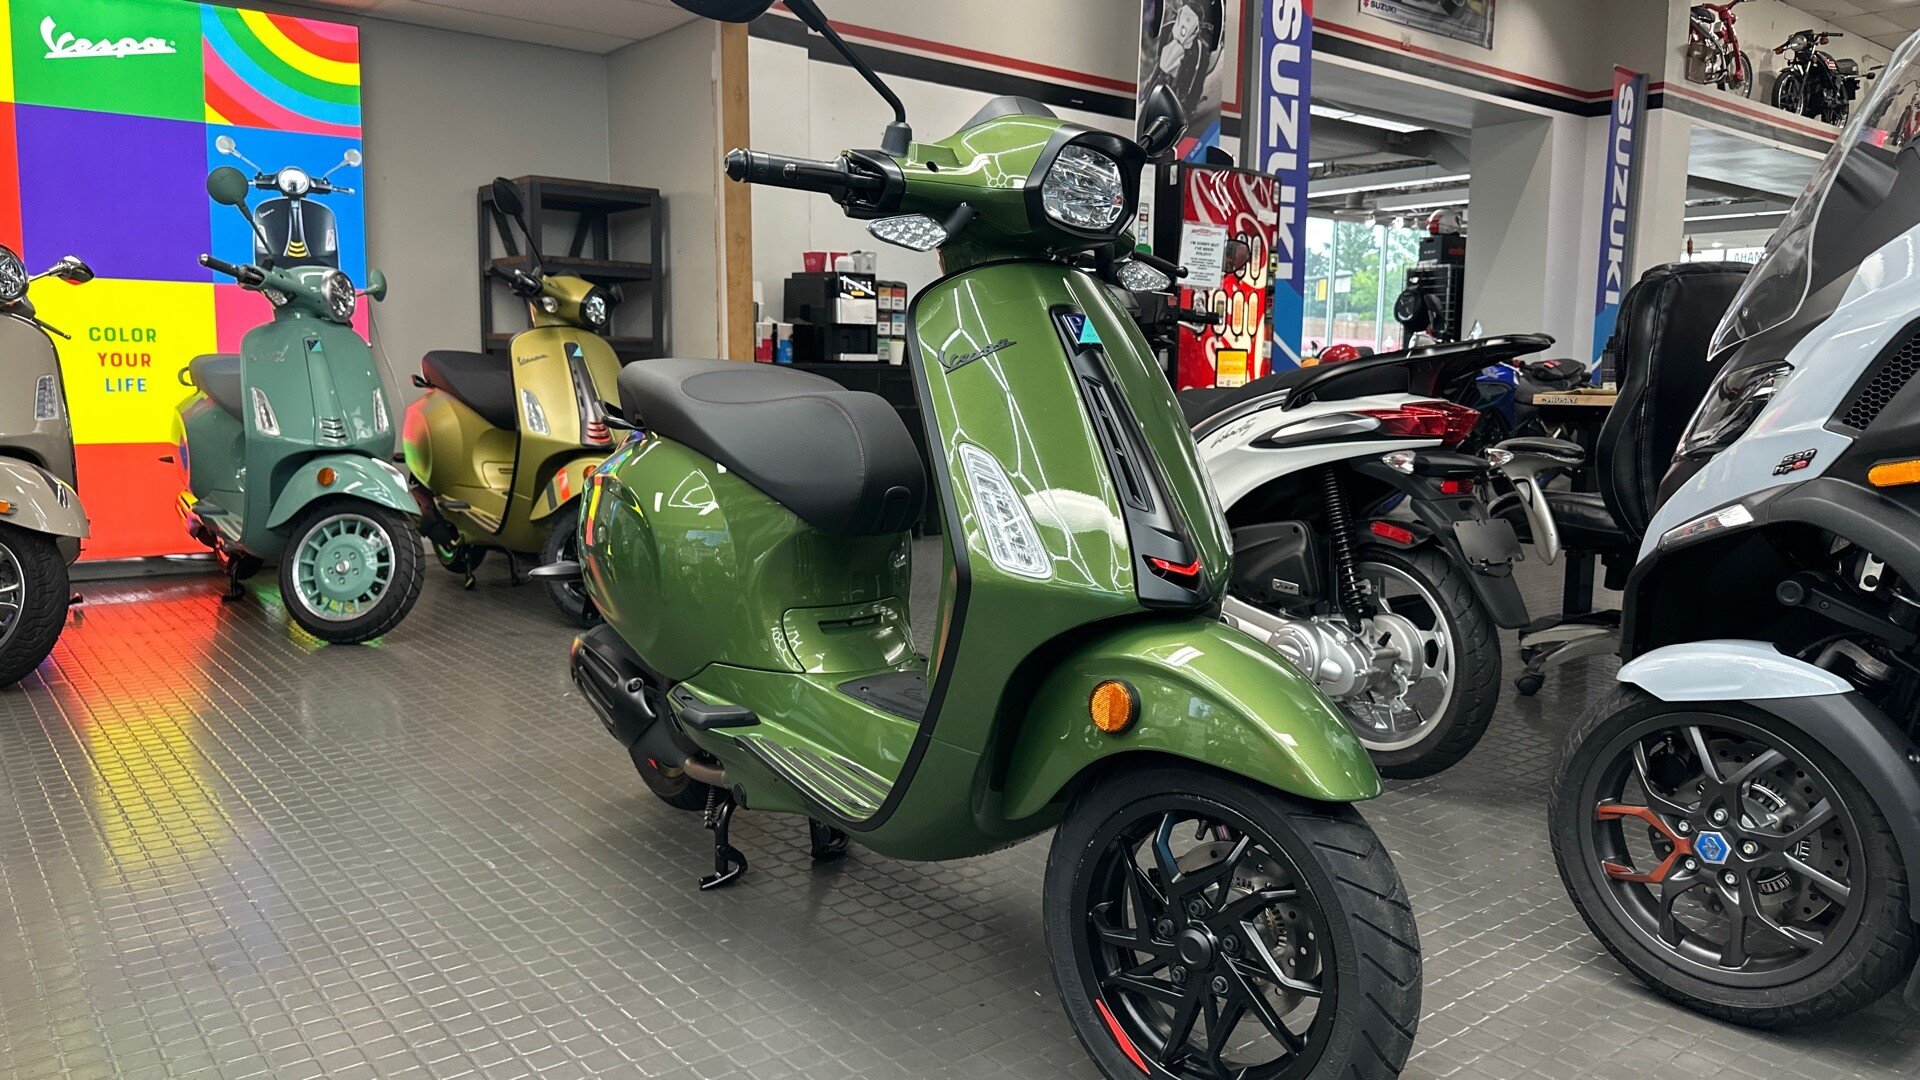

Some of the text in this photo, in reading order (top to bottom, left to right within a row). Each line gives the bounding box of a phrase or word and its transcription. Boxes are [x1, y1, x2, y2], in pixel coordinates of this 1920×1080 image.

[1370, 0, 1397, 14] SUZUKI
[40, 15, 177, 59] Vespa
[1267, 0, 1302, 280] SUZUKI
[1605, 83, 1634, 305] SUZUKI
[88, 326, 157, 343] COLOR
[97, 352, 151, 367] YOUR
[937, 338, 1017, 375] Vespa
[105, 377, 147, 392] LIFE
